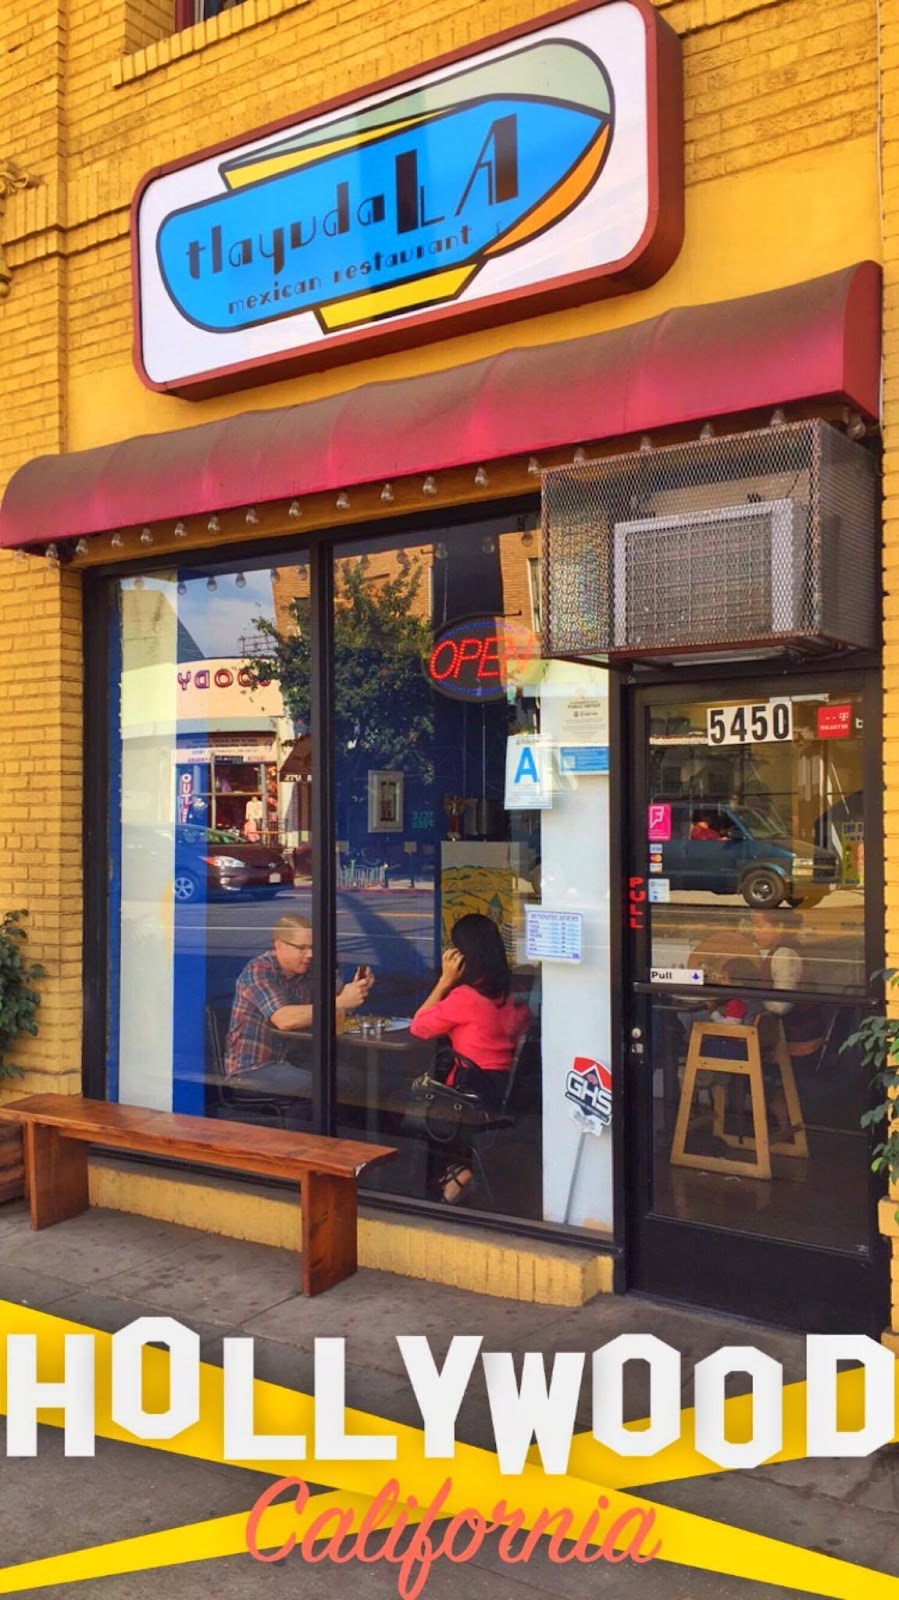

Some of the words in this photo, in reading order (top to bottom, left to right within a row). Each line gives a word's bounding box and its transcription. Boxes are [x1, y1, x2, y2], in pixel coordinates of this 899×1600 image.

[227, 275, 322, 315] mexican
[333, 225, 472, 284] restaurant
[430, 635, 536, 680] OPEN
[709, 703, 790, 744] 5450
[514, 746, 540, 783] A
[629, 876, 646, 929] PULL
[651, 971, 673, 979] Pull
[566, 1071, 612, 1117] GHS
